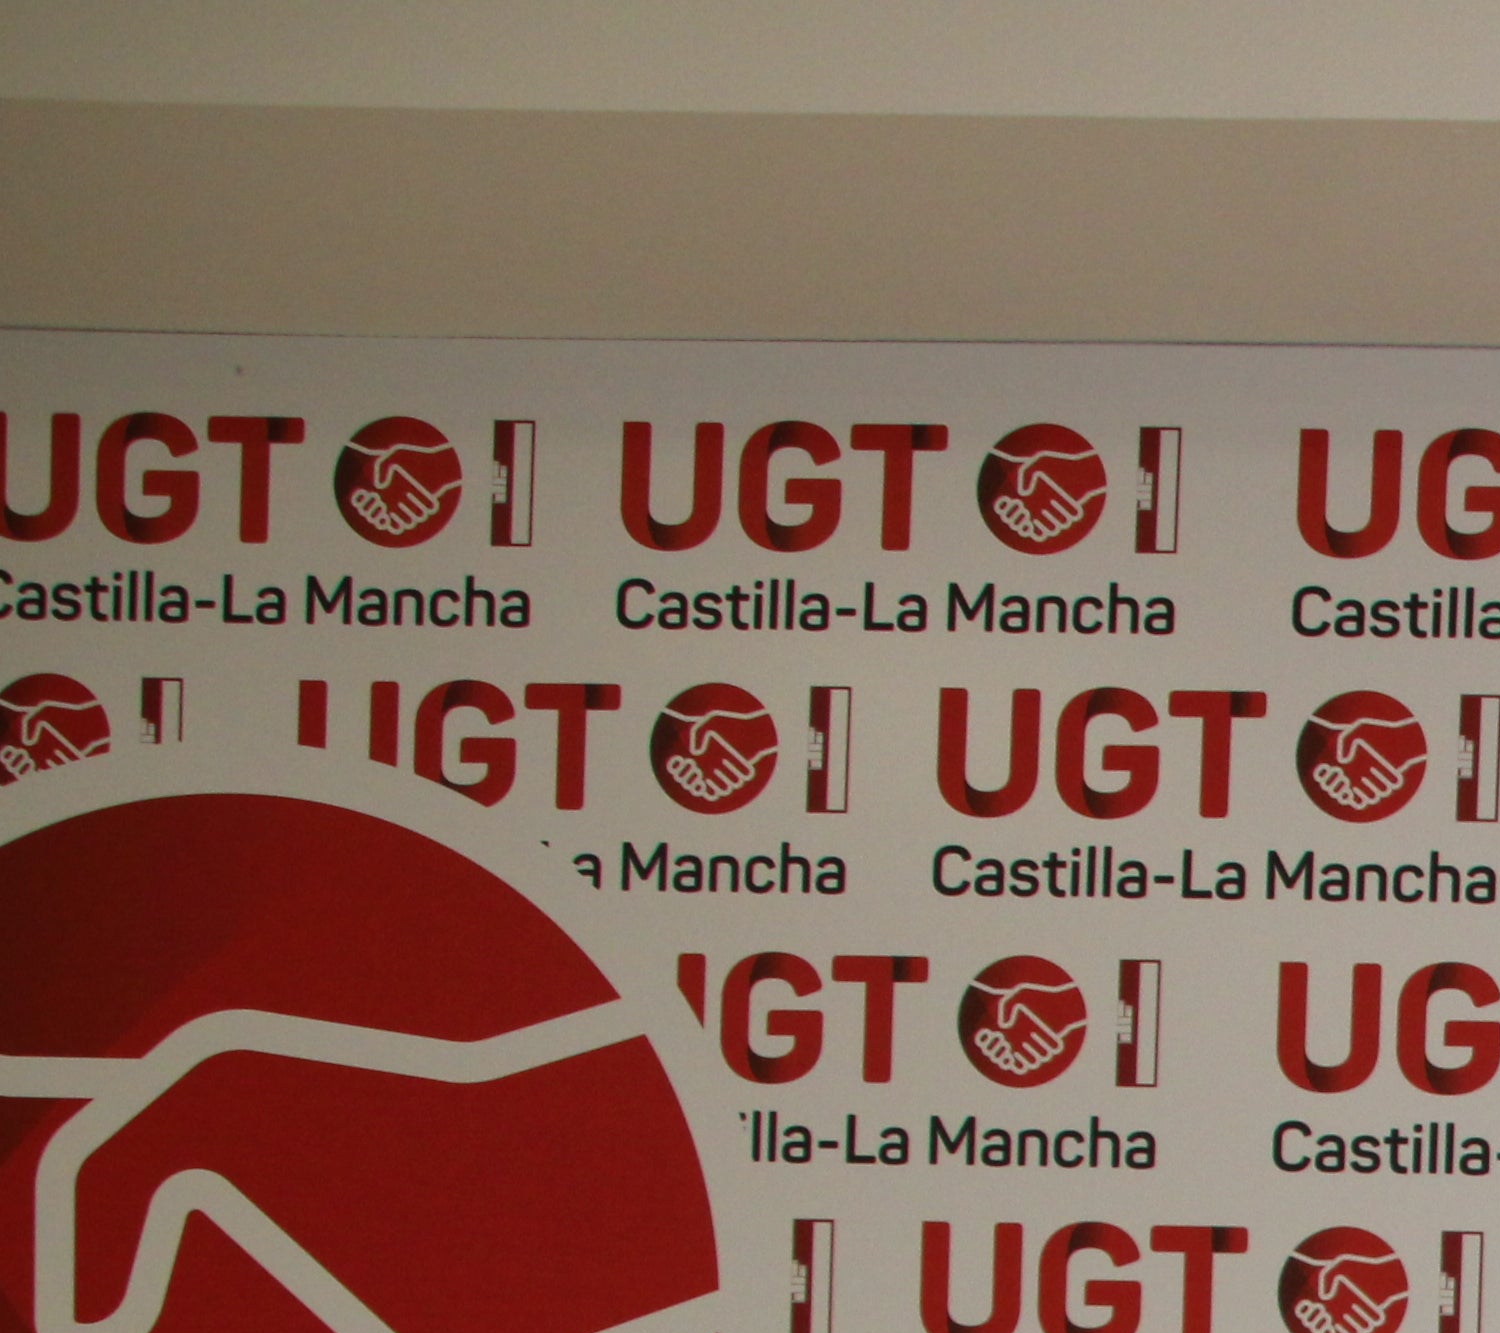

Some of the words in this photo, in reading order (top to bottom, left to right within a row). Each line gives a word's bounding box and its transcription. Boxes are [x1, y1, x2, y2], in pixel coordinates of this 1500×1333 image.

[0, 411, 305, 544] UGT
[621, 421, 949, 553] UGT
[306, 575, 530, 628] Mancha
[617, 578, 928, 632] Castilla-La
[948, 583, 1175, 635] Mancha
[937, 687, 1267, 820] UGT
[622, 842, 846, 895] Mancha
[933, 845, 1246, 900] Castilla-La
[1267, 851, 1496, 904] Mancha
[677, 952, 929, 1084] GT
[739, 1111, 909, 1165] lla-La
[930, 1116, 1156, 1170] Mancha
